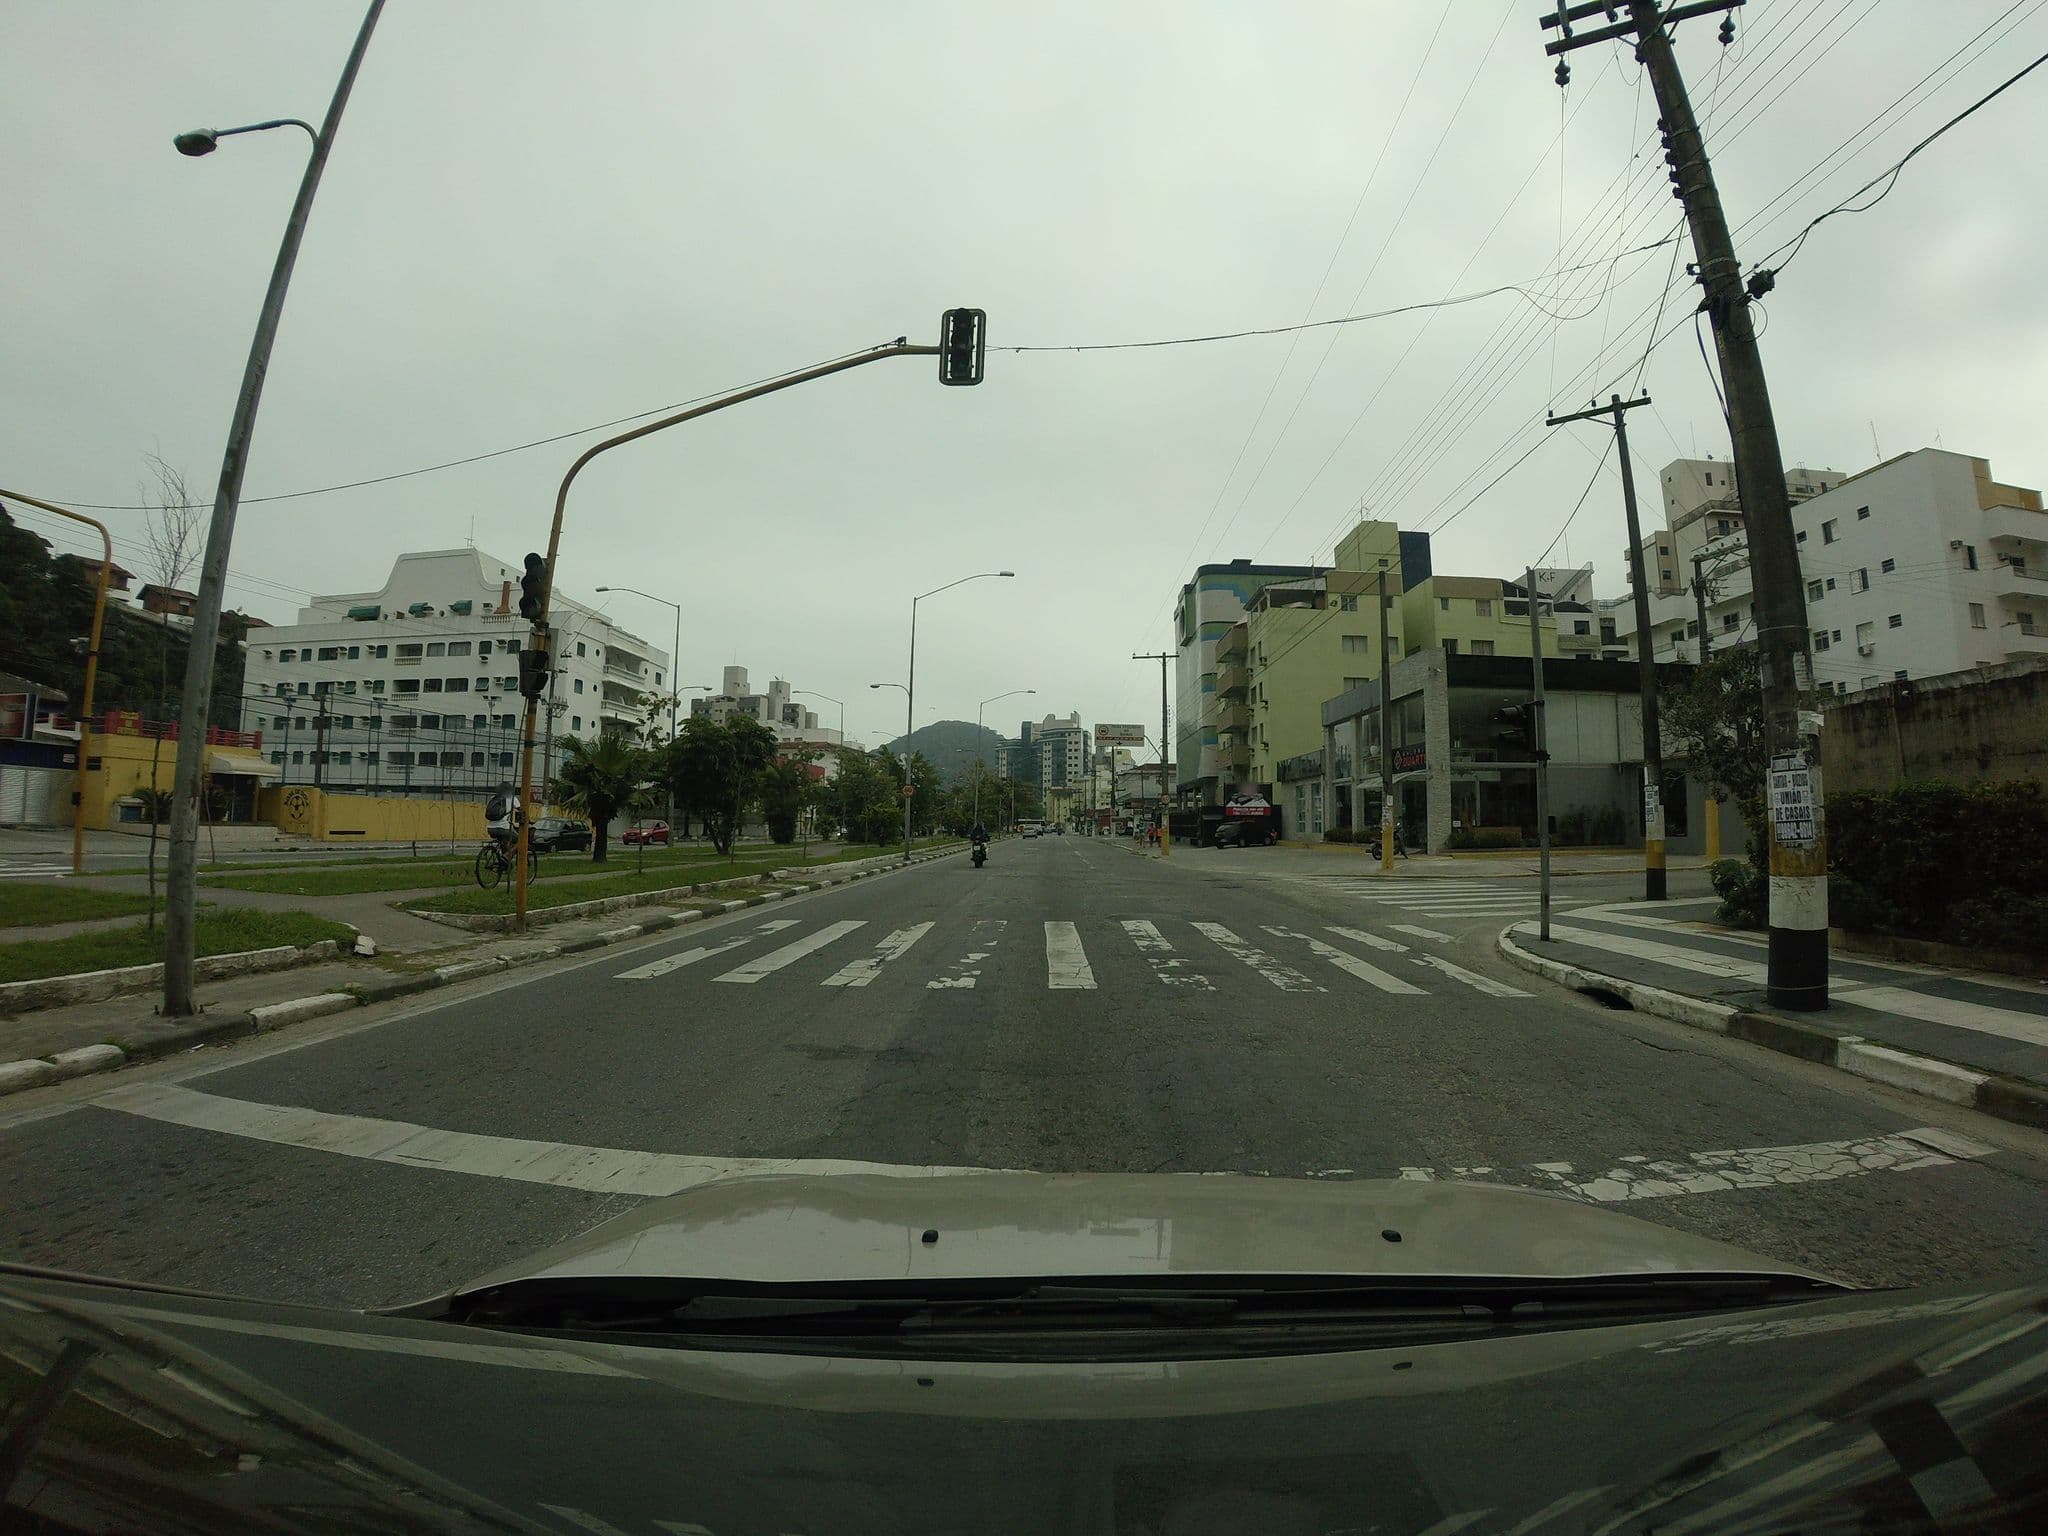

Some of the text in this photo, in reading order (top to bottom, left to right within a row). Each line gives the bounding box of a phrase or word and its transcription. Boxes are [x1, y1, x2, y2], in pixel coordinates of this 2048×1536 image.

[1780, 788, 1802, 805] UNIÃO
[1776, 806, 1811, 820] DE CASAIS
